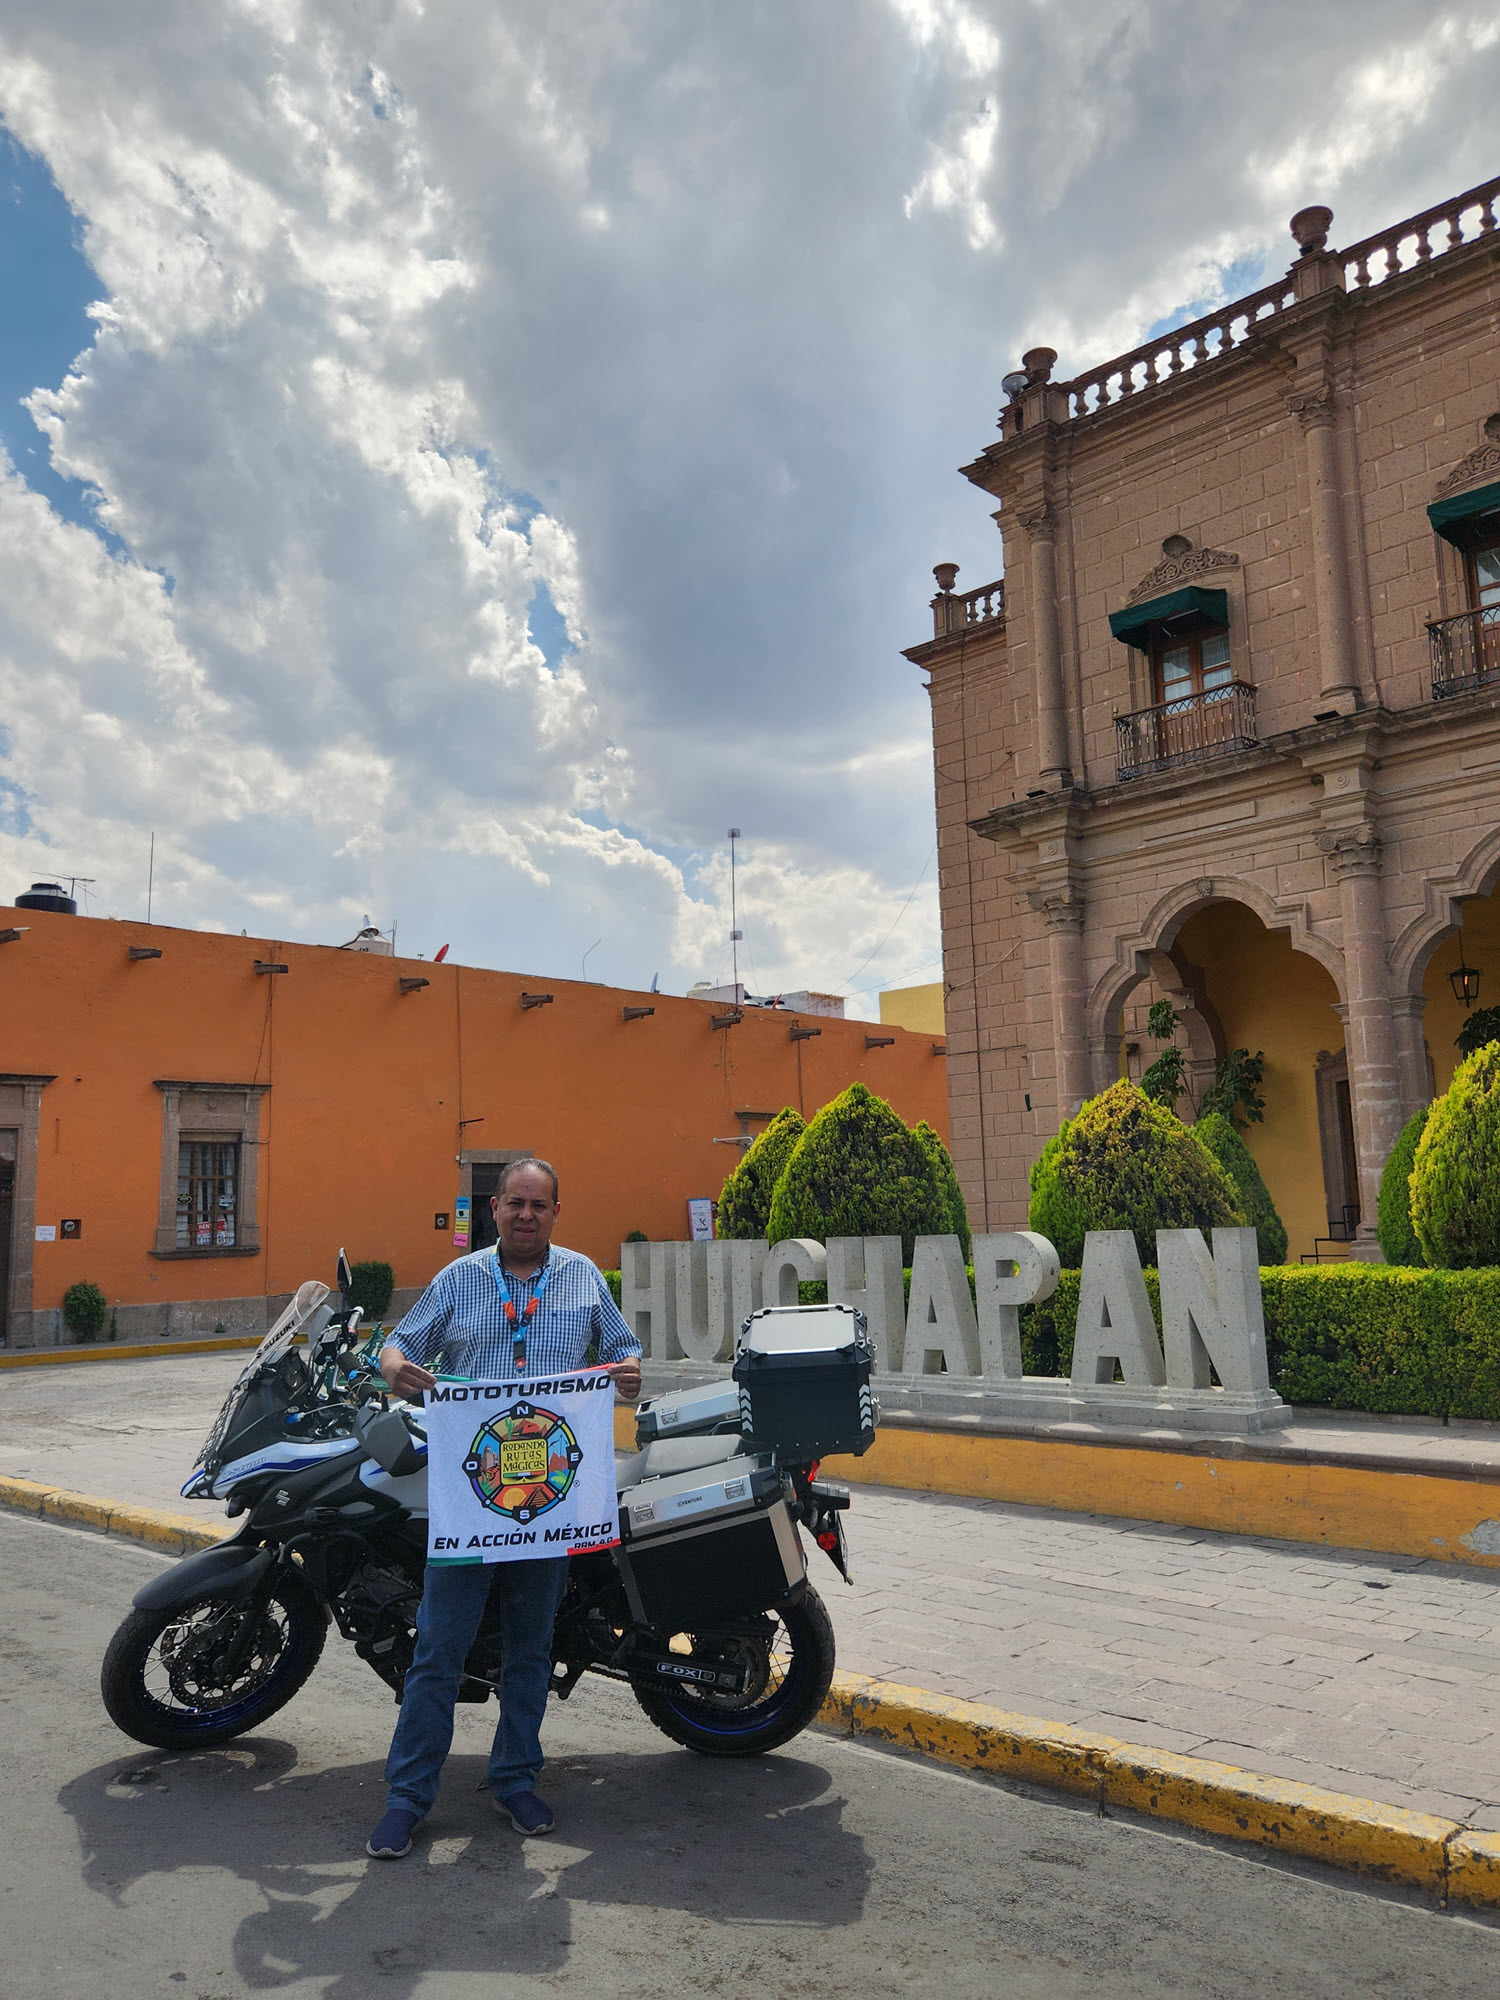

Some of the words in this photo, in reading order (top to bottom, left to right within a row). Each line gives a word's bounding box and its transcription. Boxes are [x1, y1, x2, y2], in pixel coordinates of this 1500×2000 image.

[620, 1226, 1270, 1392] HUICHAPAN
[263, 1320, 295, 1352] SUZUKI
[430, 1375, 611, 1403] MOTOTURISMO
[516, 1405, 529, 1416] N
[571, 1452, 580, 1462] E
[465, 1460, 478, 1471] O
[519, 1509, 530, 1519] S
[434, 1537, 460, 1550] EN
[466, 1528, 537, 1549] ACCIÓN
[544, 1522, 613, 1543] MÉXICO
[574, 1540, 596, 1550] RRM
[660, 1664, 697, 1677] FOX
